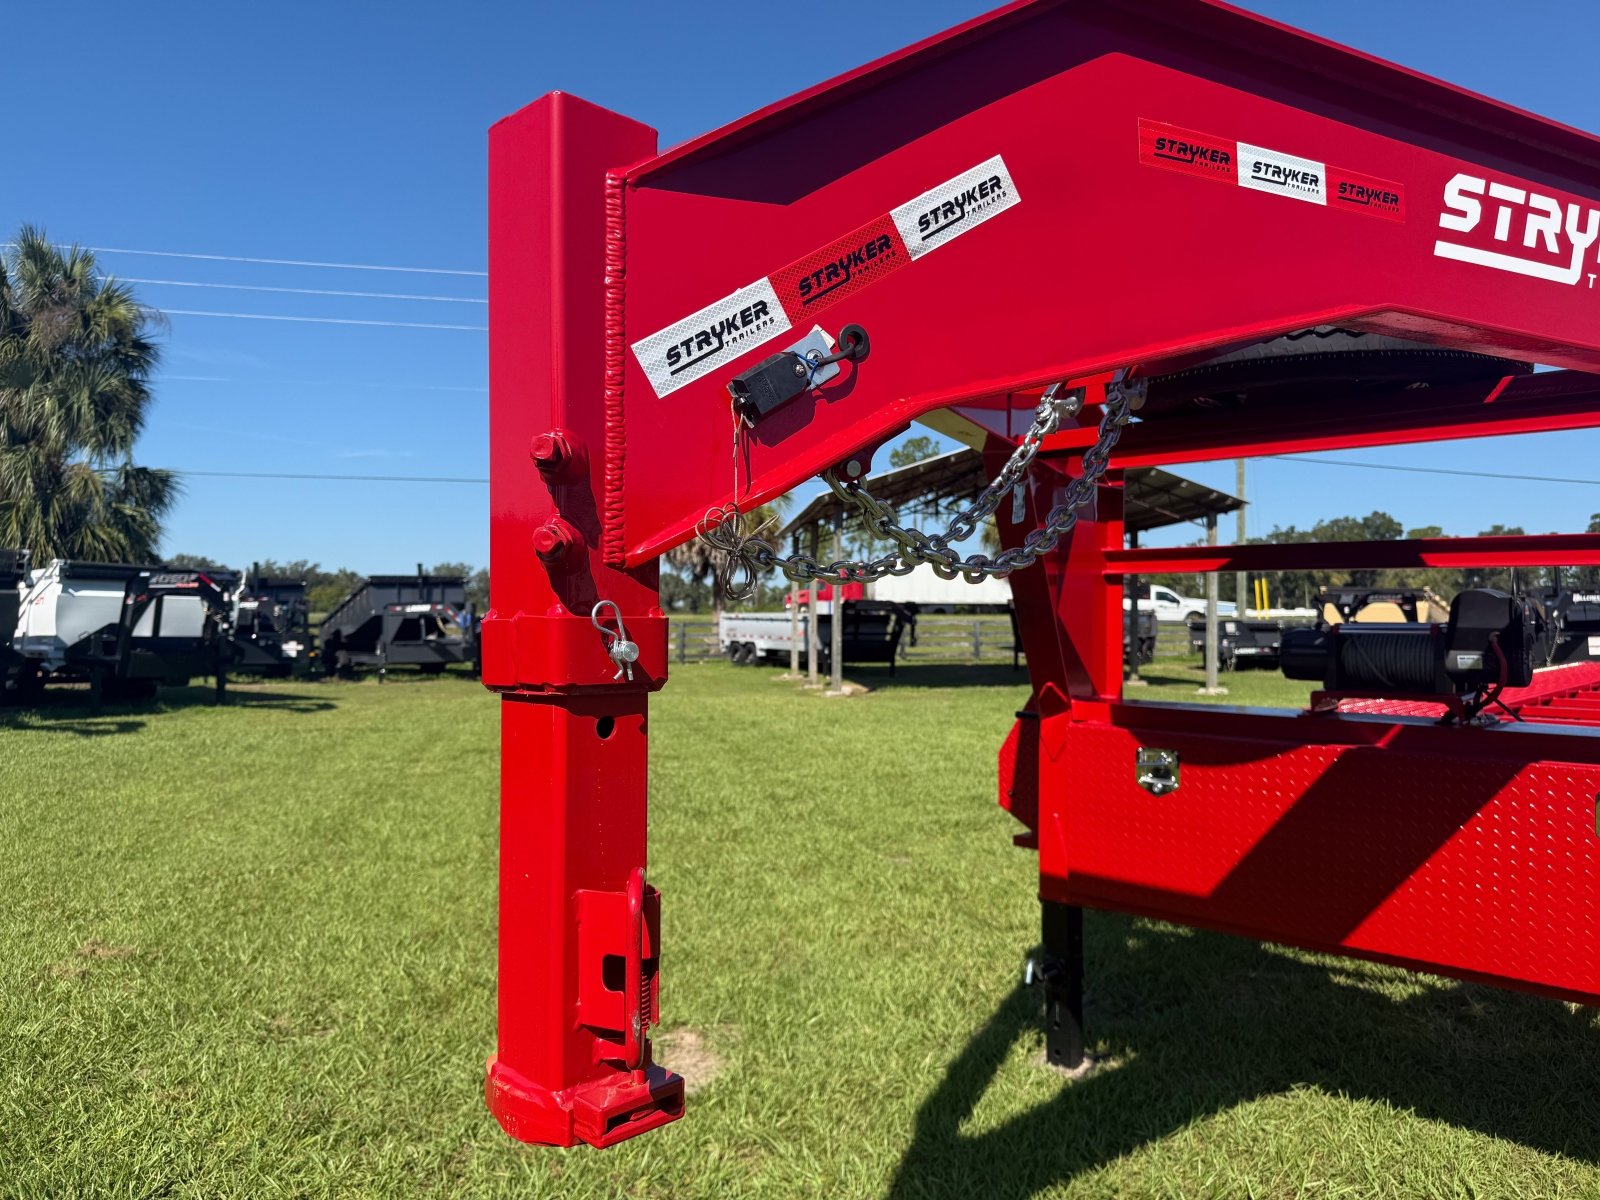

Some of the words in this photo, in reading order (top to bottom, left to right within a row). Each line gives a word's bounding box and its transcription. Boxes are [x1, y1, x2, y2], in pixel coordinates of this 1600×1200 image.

[1154, 137, 1231, 163] STRYKER
[1194, 160, 1231, 173] TRAILERS
[1251, 161, 1319, 186] STRYKER
[1286, 183, 1320, 195] TRAILERS
[1337, 181, 1399, 205] STRYKER
[918, 174, 1002, 241] STRYKER
[965, 190, 1008, 218] TRAILERS
[1433, 173, 1600, 286] STRY
[798, 234, 892, 307] STRYKER
[851, 250, 898, 278] TRAILERS
[666, 300, 770, 376] STRYKER
[725, 316, 776, 348] TRAILERS
